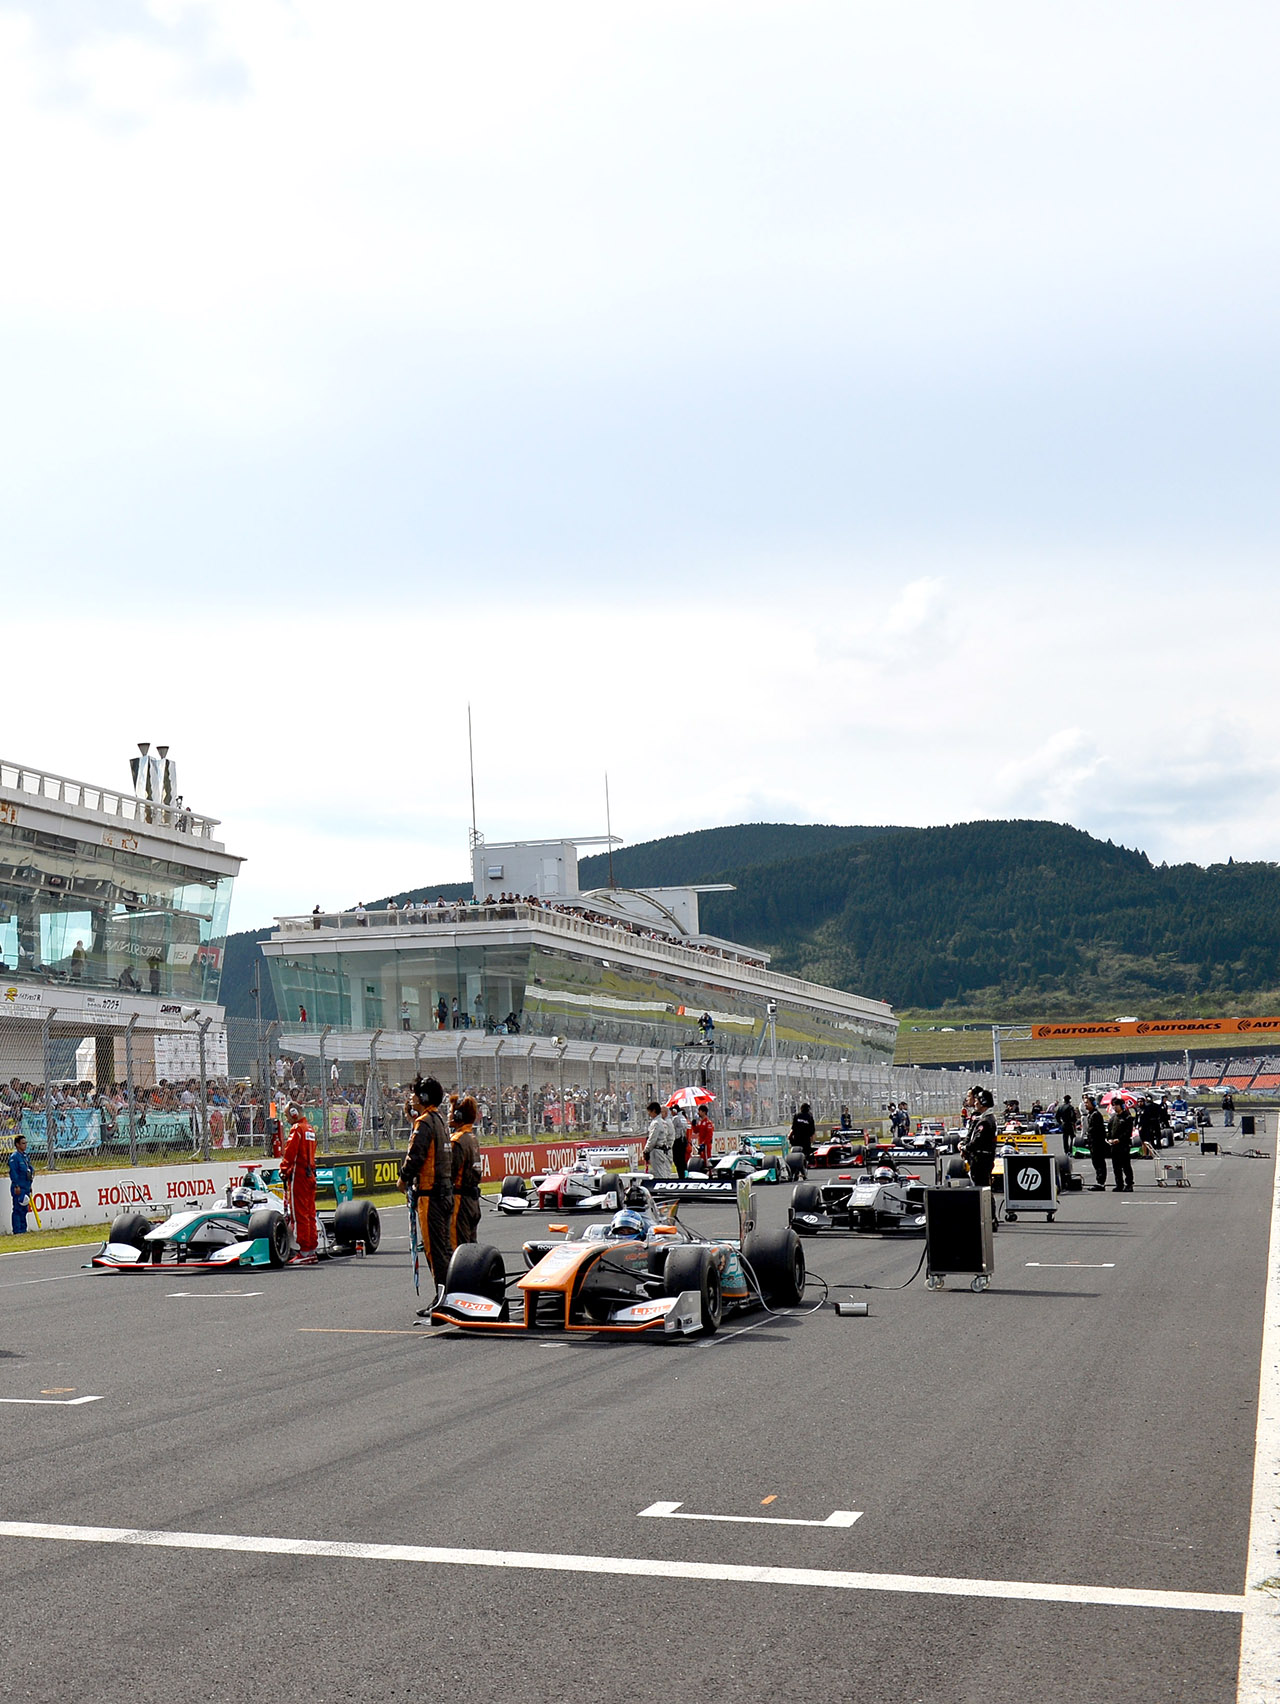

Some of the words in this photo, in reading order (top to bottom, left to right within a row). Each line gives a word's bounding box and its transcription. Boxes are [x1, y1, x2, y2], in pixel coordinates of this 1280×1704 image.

[1052, 1025, 1121, 1035] AUTOBACS
[1151, 1022, 1221, 1032] AUTOBACS
[503, 1152, 535, 1174] TOYOTA
[374, 1162, 400, 1183] ZOIL
[1021, 1167, 1038, 1191] hp
[166, 1179, 216, 1199] HONDA
[653, 1182, 733, 1191] POTENZA
[98, 1184, 153, 1206] HONDA
[458, 1300, 489, 1311] LIXIL
[634, 1304, 669, 1315] LIXIL
